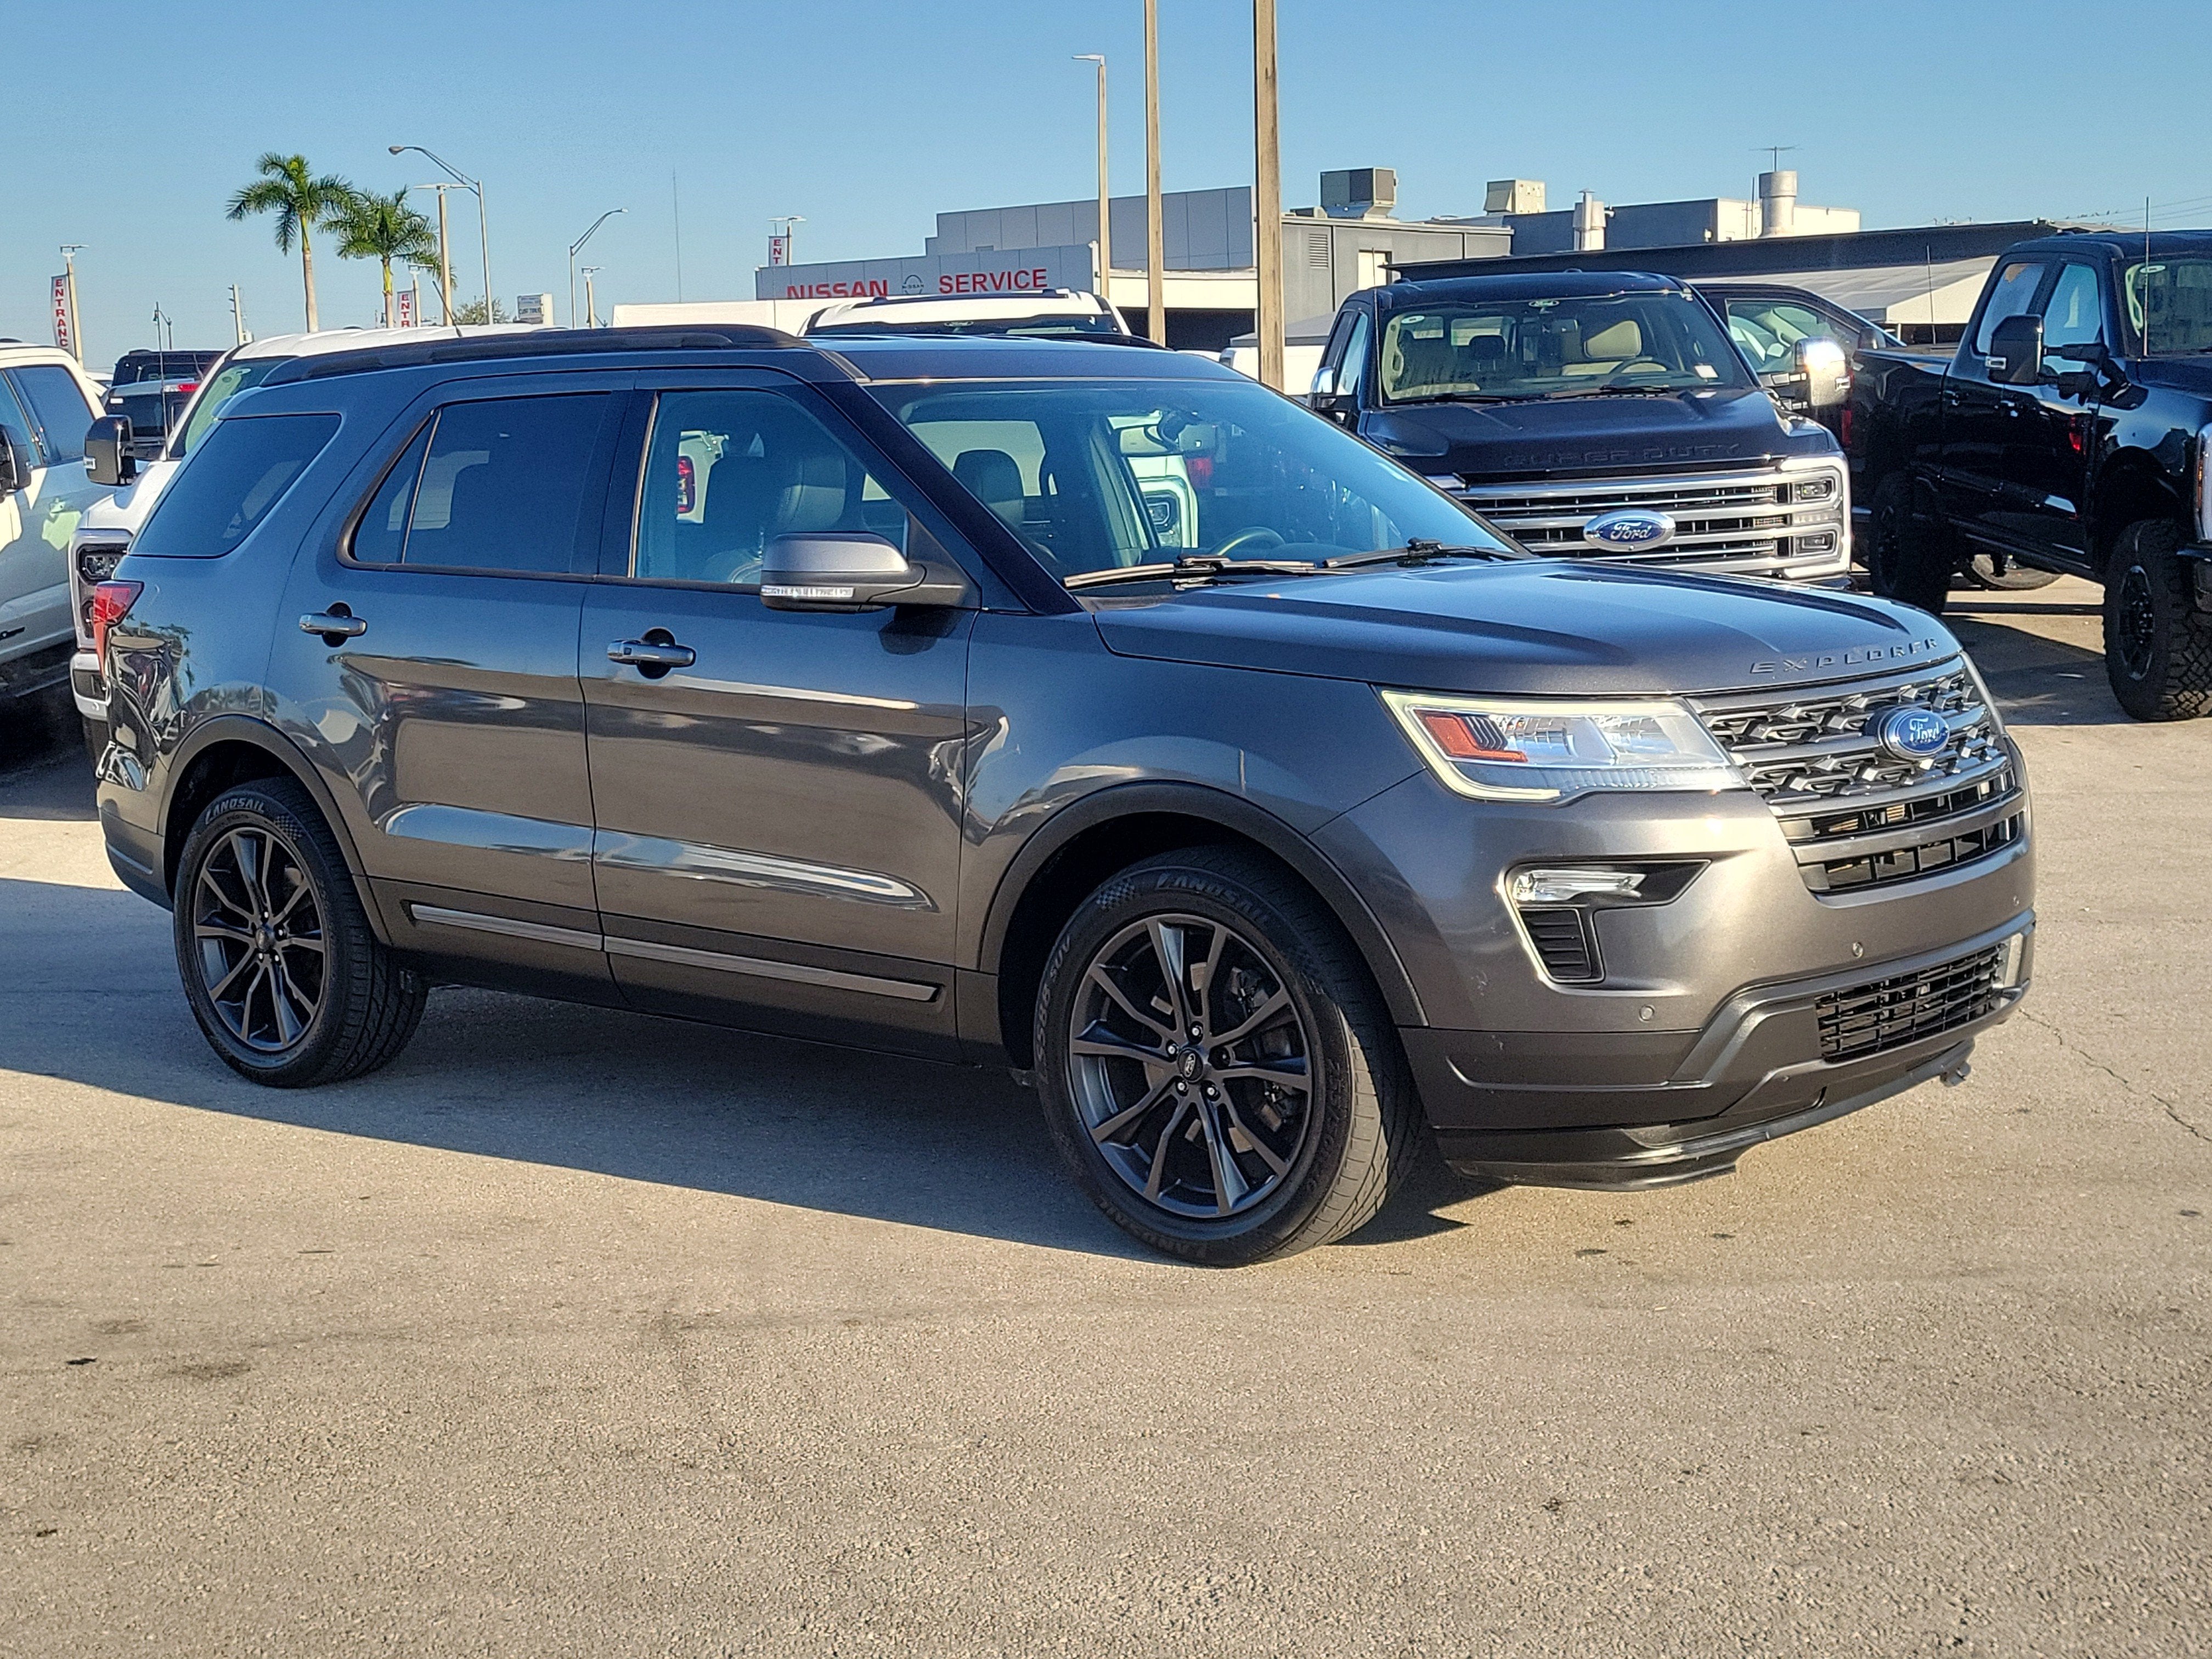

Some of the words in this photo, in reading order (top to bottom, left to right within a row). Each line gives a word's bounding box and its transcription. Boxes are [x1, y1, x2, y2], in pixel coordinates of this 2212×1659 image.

[787, 280, 887, 298] NISSAN
[939, 269, 1047, 294] SERVICE
[55, 279, 69, 348] ENTRANC
[1610, 521, 1652, 541] Ford
[1750, 637, 1938, 674] EXPLORER
[1909, 717, 1940, 743] Ford
[205, 797, 266, 825] LANDSAIL
